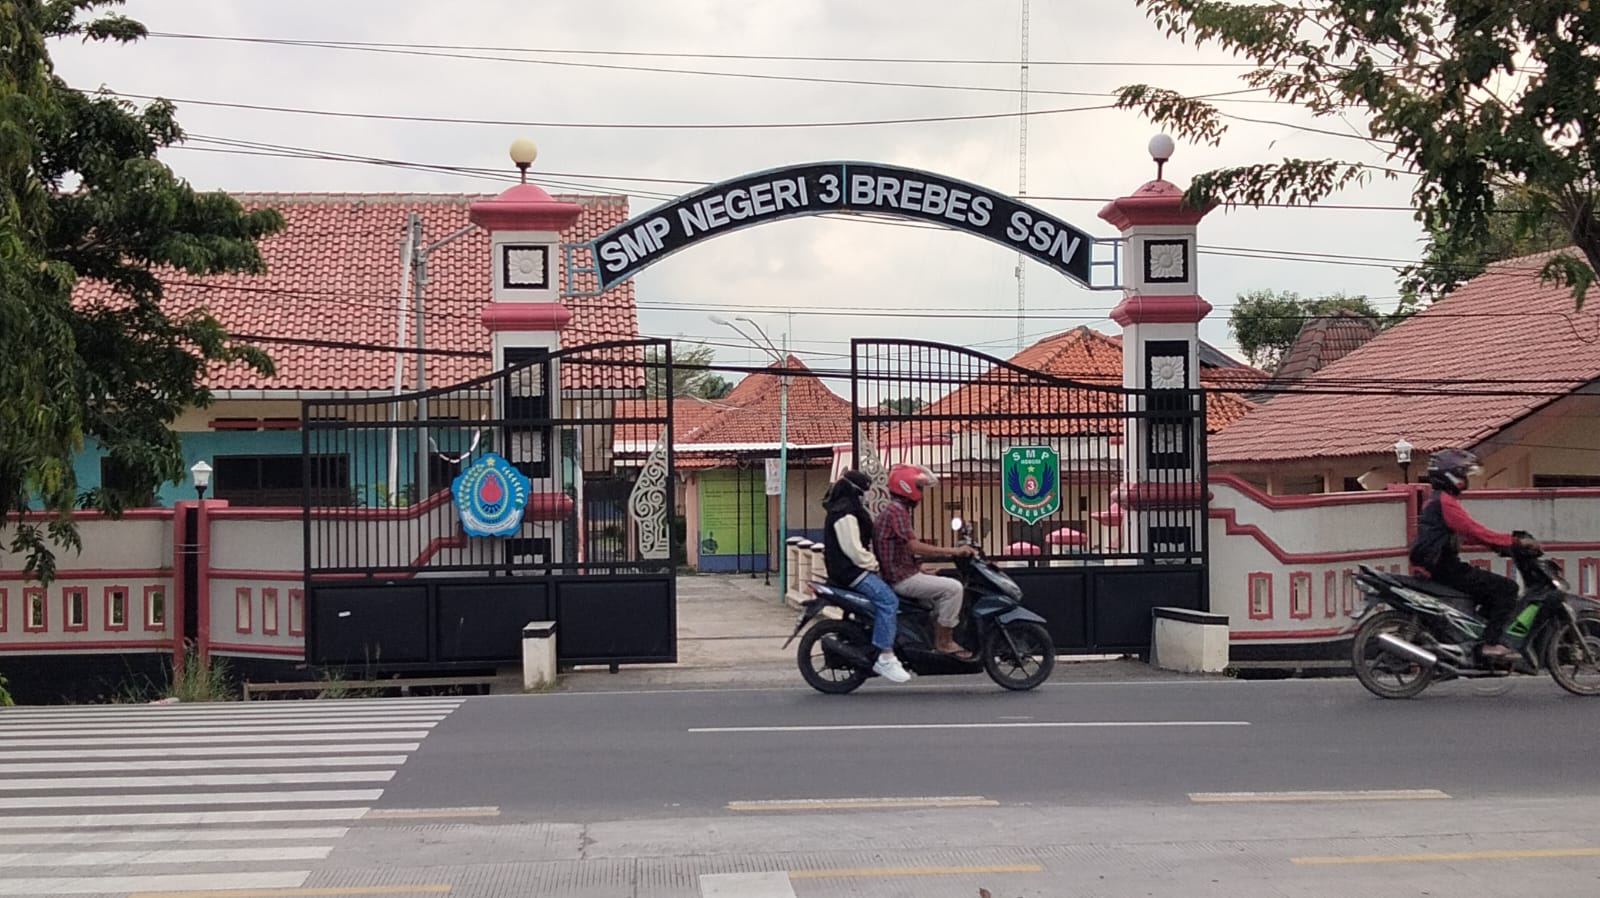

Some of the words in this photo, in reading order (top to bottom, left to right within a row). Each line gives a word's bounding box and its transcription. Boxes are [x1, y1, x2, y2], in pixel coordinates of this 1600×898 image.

[600, 216, 671, 273] SMP
[678, 176, 809, 237] NEGERI
[818, 174, 840, 204] 3
[851, 174, 994, 227] BREBES
[1006, 211, 1081, 264] SSN
[1027, 481, 1035, 490] 3
